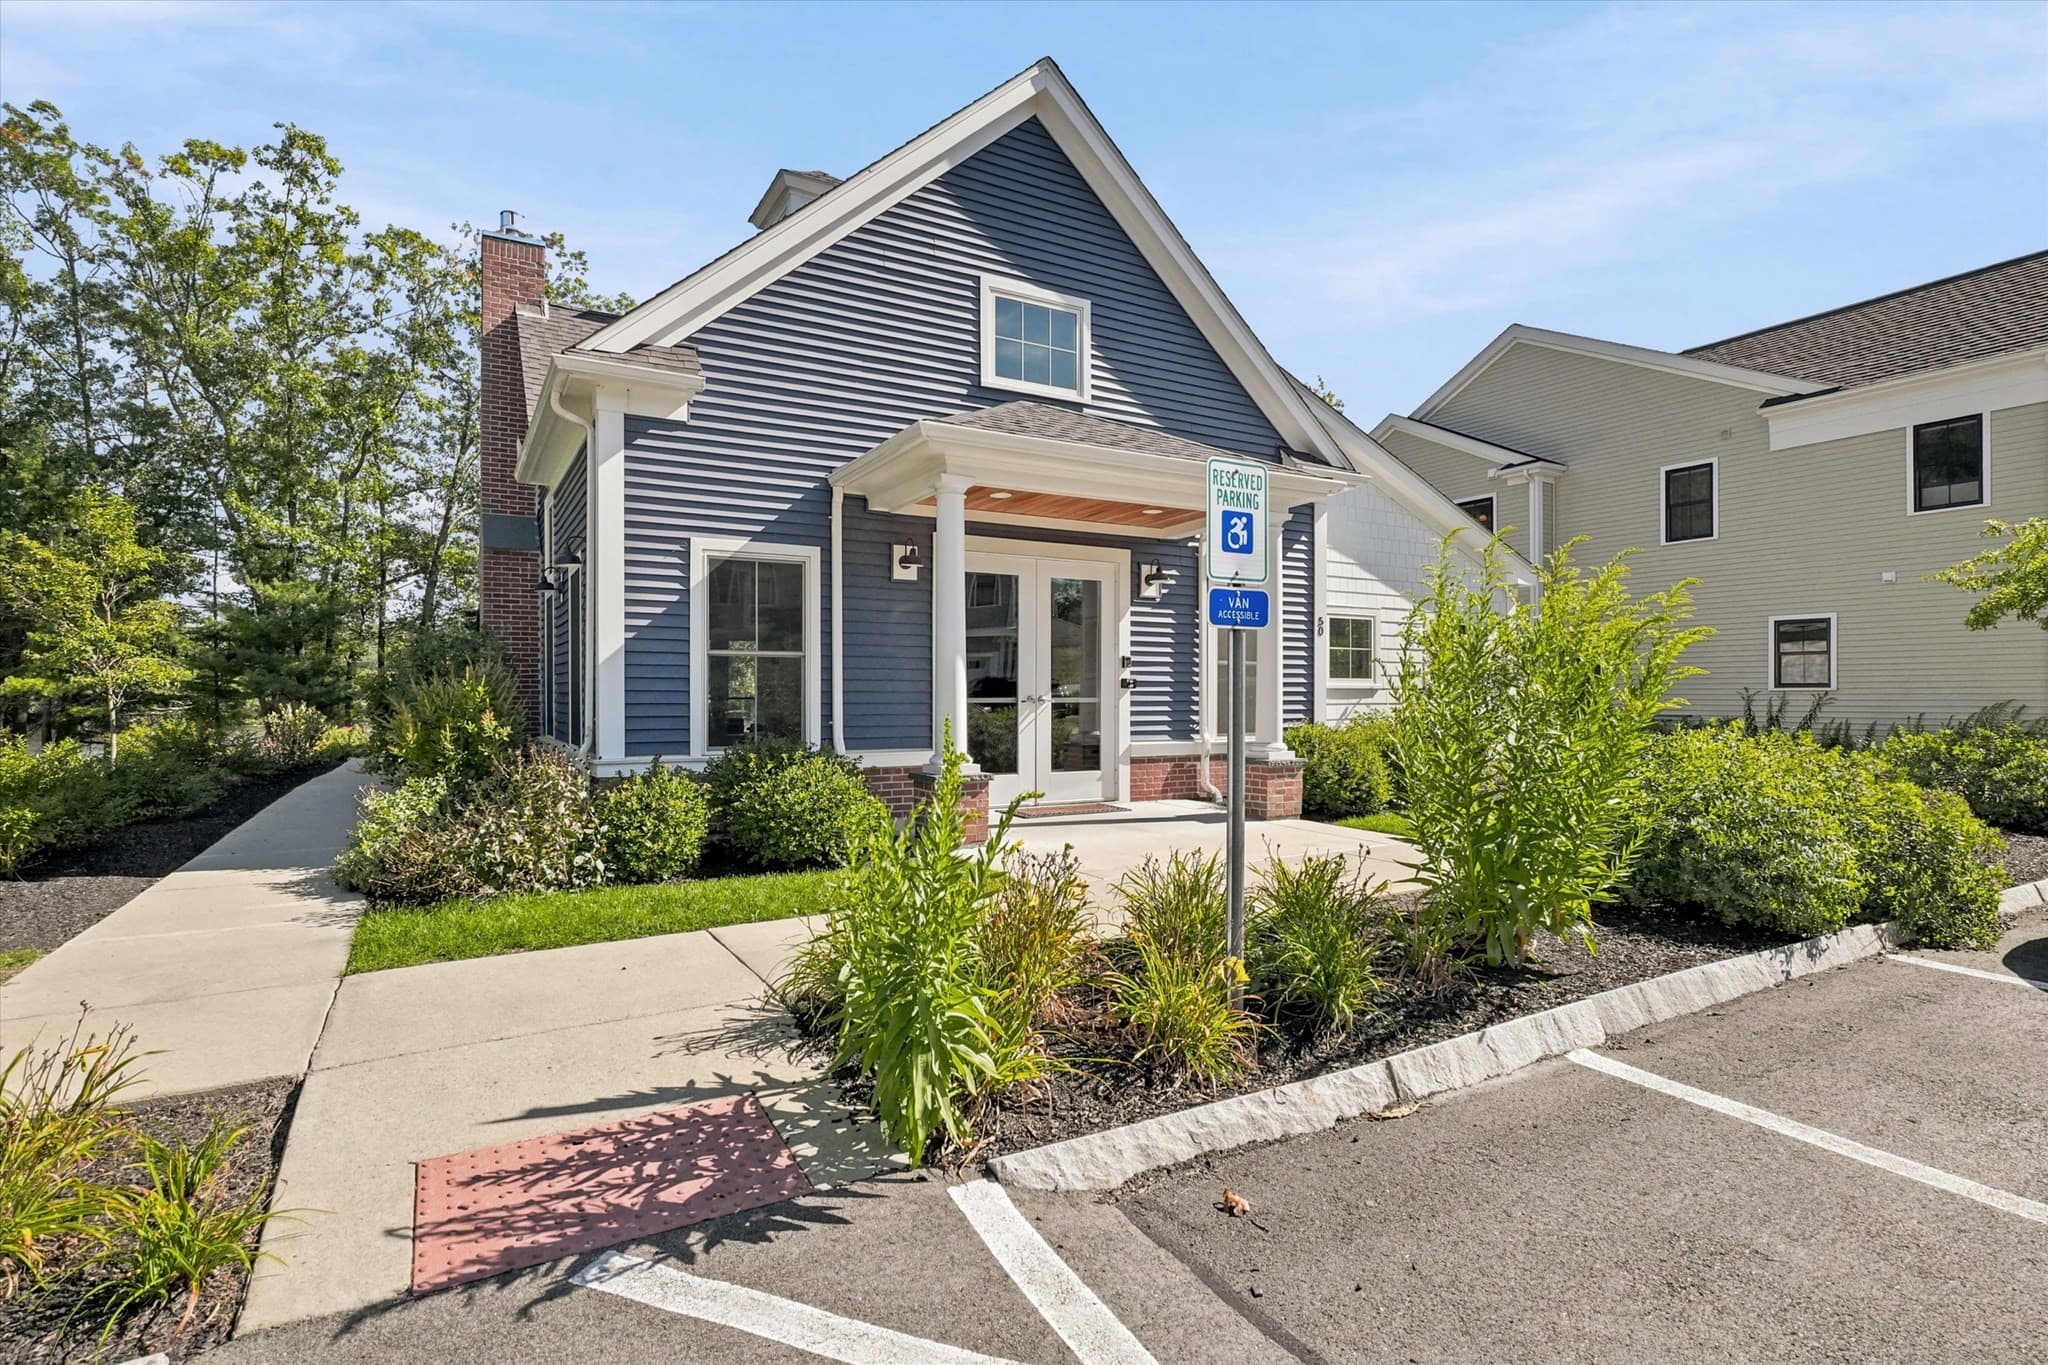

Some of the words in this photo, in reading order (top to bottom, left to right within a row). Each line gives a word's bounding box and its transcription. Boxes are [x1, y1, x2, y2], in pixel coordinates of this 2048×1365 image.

[1213, 468, 1263, 491] RESERVED
[1216, 488, 1260, 510] PARKING
[1228, 597, 1249, 609] VAN
[1217, 609, 1260, 621] ACCESSIBLE
[1317, 616, 1324, 636] 50
